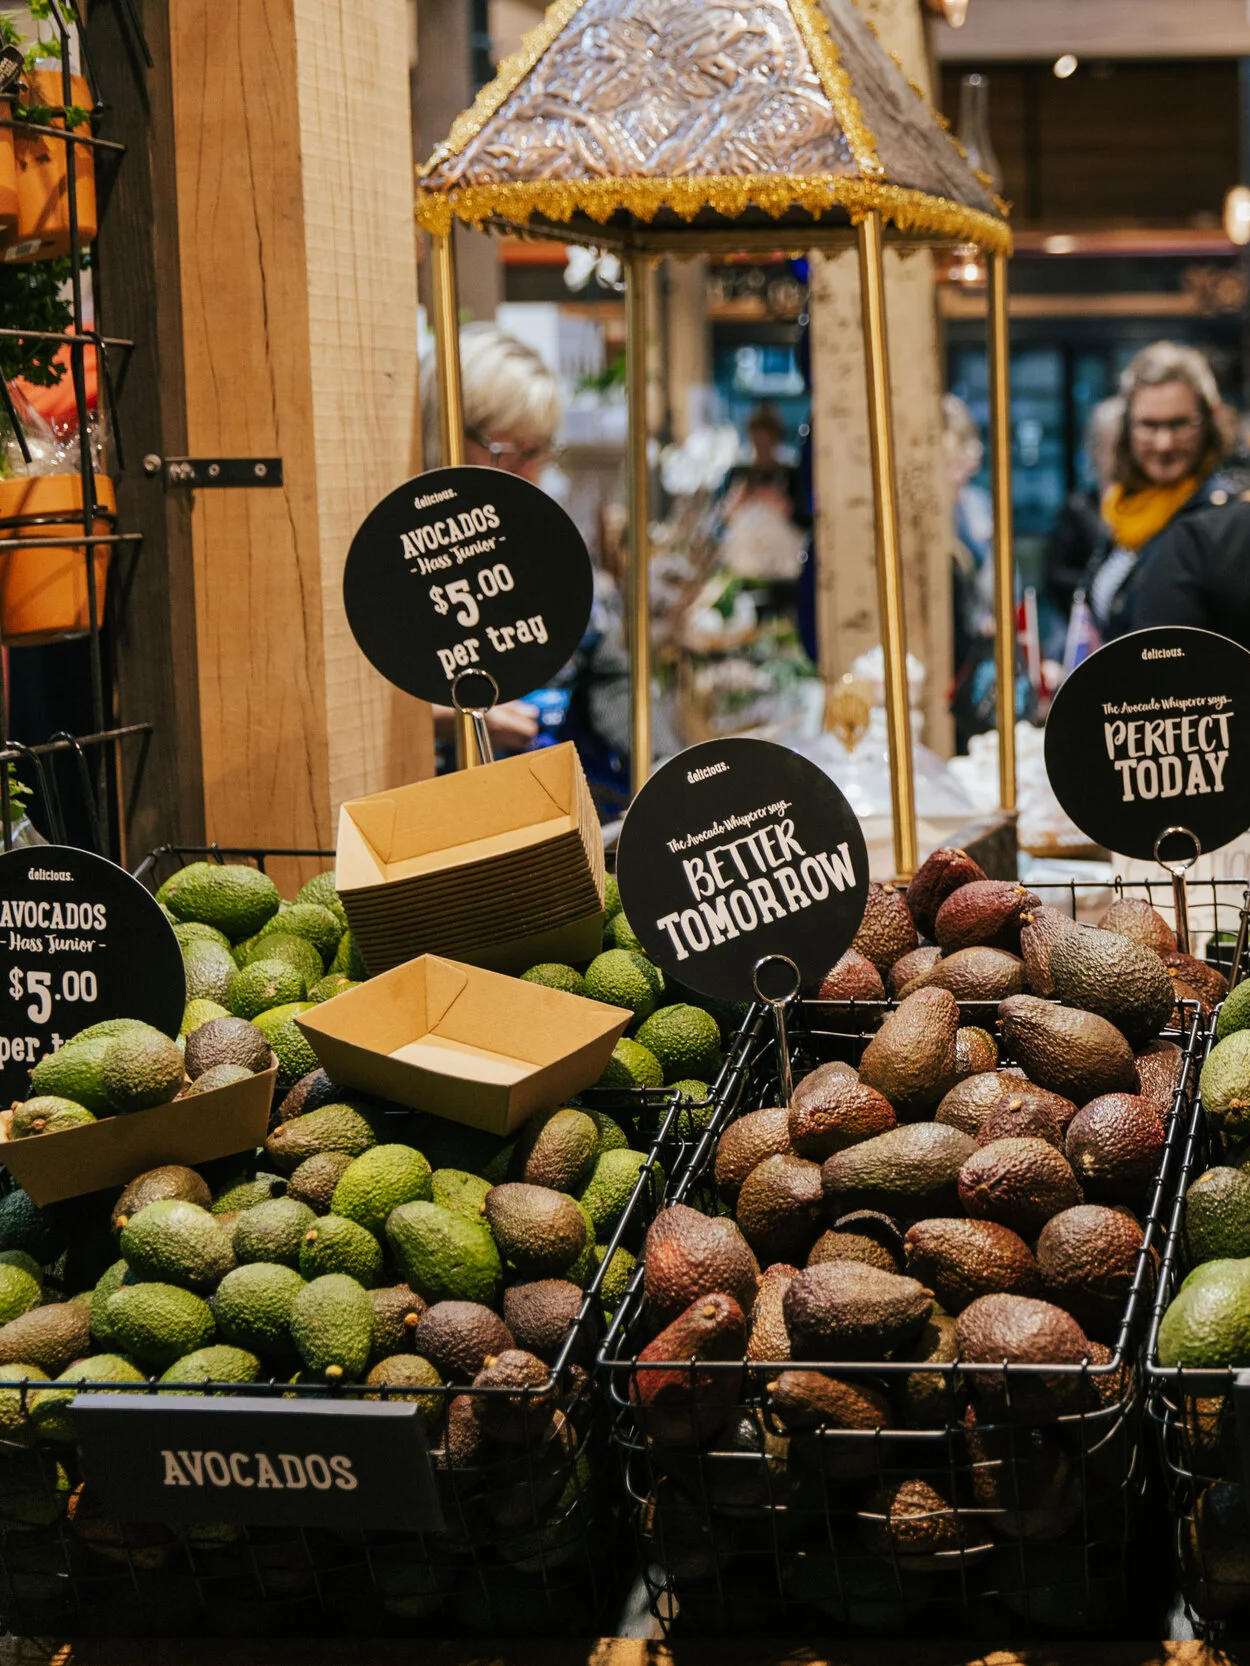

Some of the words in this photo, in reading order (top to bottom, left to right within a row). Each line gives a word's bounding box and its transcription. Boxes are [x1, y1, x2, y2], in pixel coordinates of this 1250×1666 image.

[414, 488, 457, 509] delicious.
[400, 504, 500, 560] AVOCADOS
[429, 563, 515, 627] $5.00
[437, 638, 480, 680] per
[486, 614, 549, 653] tray
[1141, 648, 1185, 661] delicious.
[1102, 702, 1120, 715] The
[1119, 698, 1160, 714] Avocado
[1160, 696, 1206, 713] Whisperer
[1104, 712, 1234, 760] PERFECT
[687, 761, 730, 784] delicious.
[1114, 750, 1229, 802] TODAY
[666, 839, 687, 853] The
[686, 821, 725, 847] Avocado
[722, 808, 767, 832] Whisperer
[28, 867, 74, 882] delicious.
[682, 818, 806, 901] BETTER
[0, 900, 107, 931] AVOCADOS
[656, 842, 856, 961] TOMORROW
[9, 966, 98, 1024] $5.00
[0, 1035, 40, 1070] per
[161, 1450, 358, 1490] AVOCADOS
